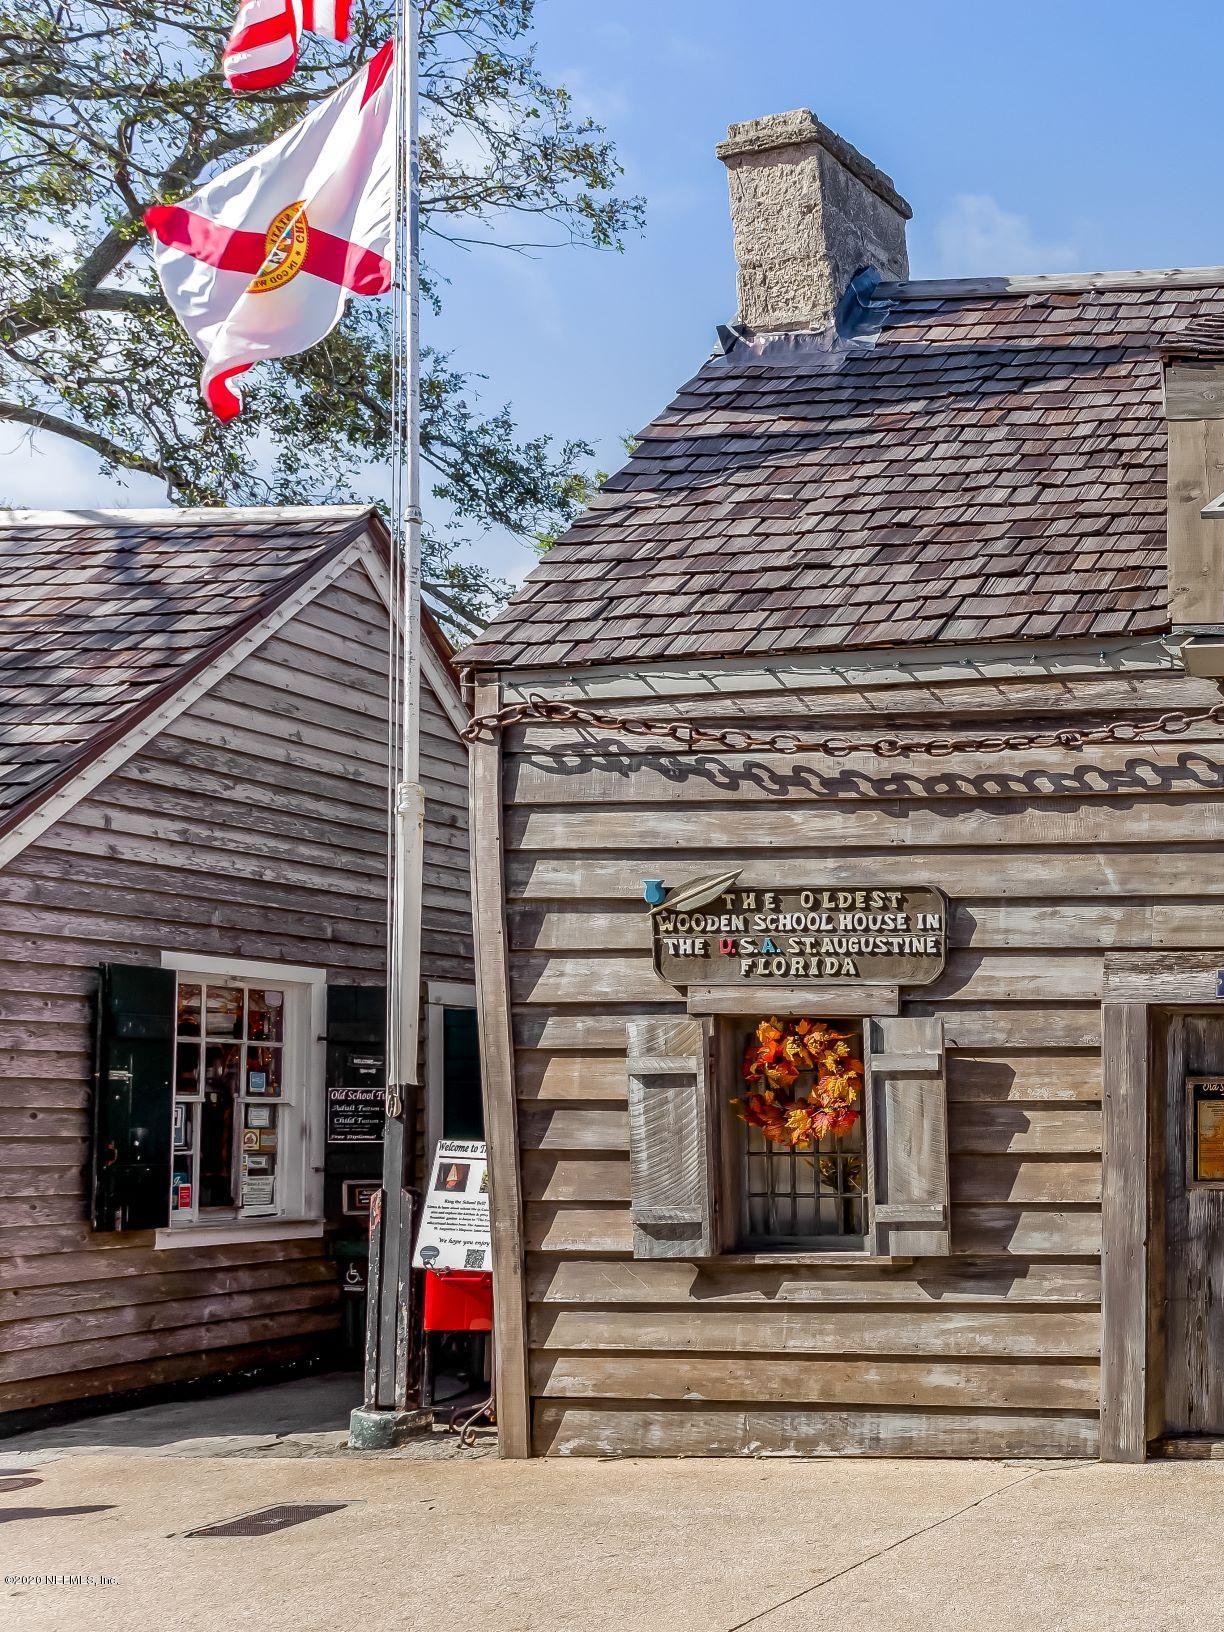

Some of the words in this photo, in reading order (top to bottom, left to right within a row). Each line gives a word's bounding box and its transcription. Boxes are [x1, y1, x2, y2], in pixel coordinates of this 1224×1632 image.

[721, 892, 776, 909] THE
[800, 890, 902, 908] OLDEST
[656, 913, 745, 931] WOODEN
[752, 912, 834, 931] SCHOOL
[839, 912, 907, 930] HOUSE
[916, 913, 940, 929] IN
[663, 938, 705, 955] THE
[719, 937, 781, 954] U.S.A.
[820, 937, 937, 953] AUGUSTINE
[740, 957, 857, 975] FLORIDA
[1202, 1083, 1219, 1091] Old
[331, 1090, 347, 1100] Old
[347, 1090, 376, 1100] School
[438, 1141, 470, 1153] Welcome
[471, 1144, 479, 1153] to
[449, 1237, 462, 1245] hope
